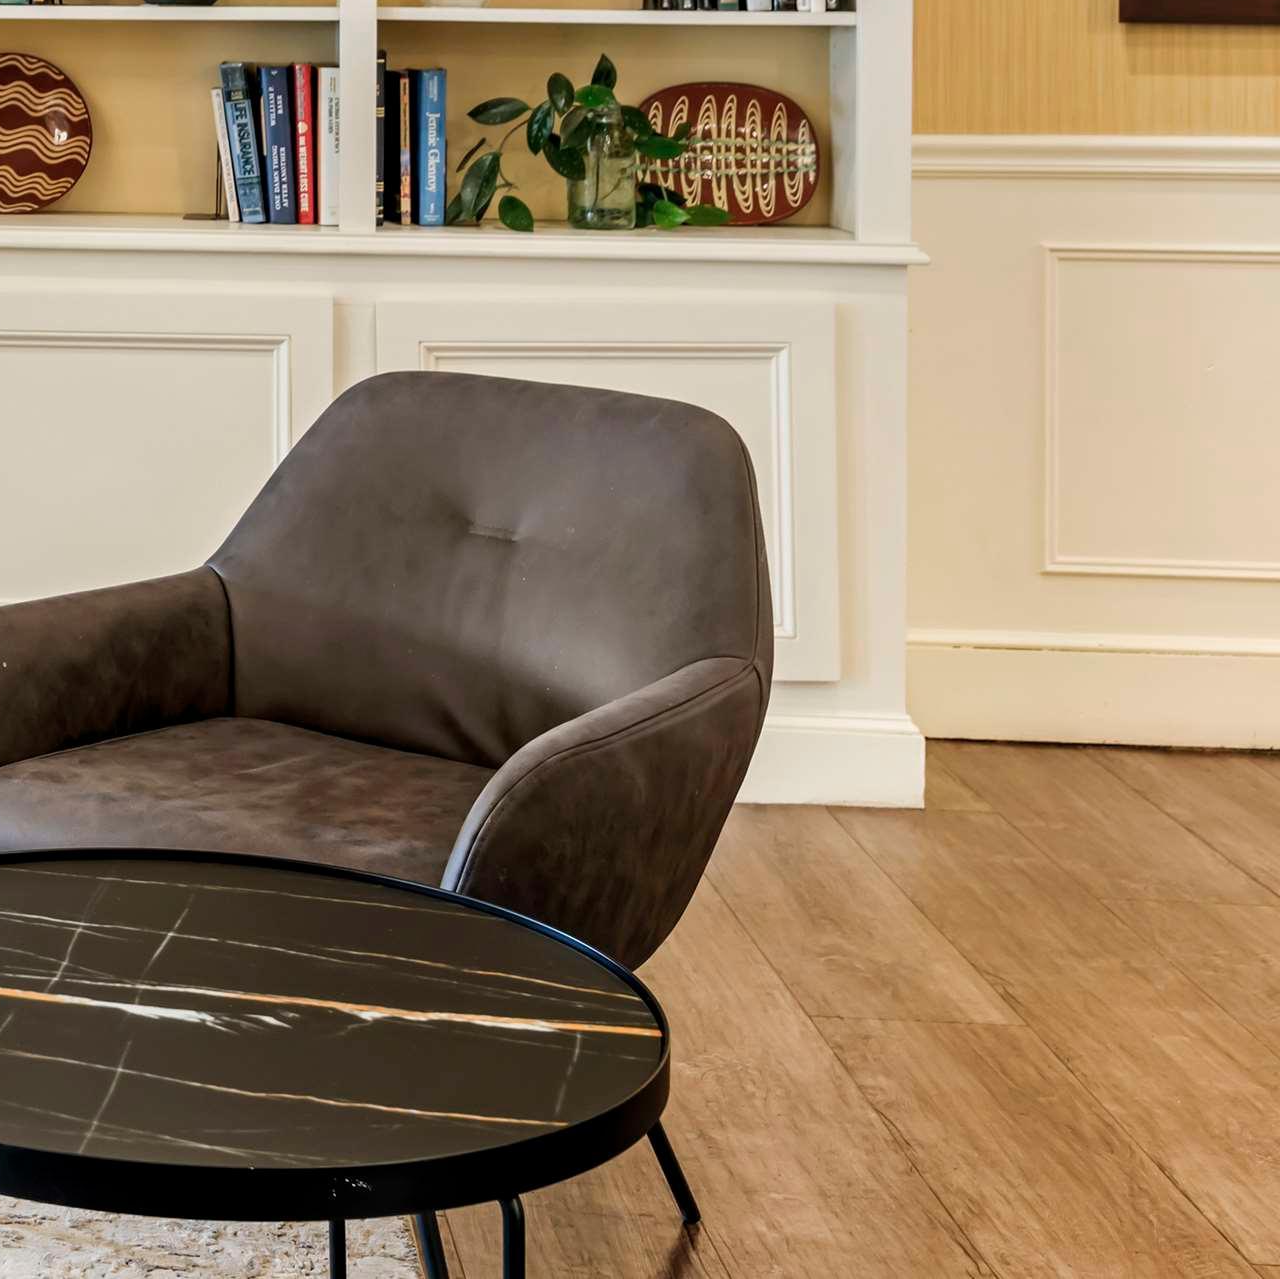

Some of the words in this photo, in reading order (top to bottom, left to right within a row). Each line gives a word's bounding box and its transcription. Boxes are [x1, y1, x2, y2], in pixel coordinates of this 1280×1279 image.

[234, 102, 249, 121] LIFE
[268, 93, 277, 127] WILLIAM
[425, 111, 441, 147] Jennie
[236, 123, 256, 177] INSURANCE
[270, 145, 279, 169] THING
[298, 147, 308, 173] WEIGHT
[278, 147, 288, 182] ANOTHER
[425, 149, 441, 193] Glenroy
[272, 170, 281, 193] DAMN
[299, 174, 308, 192] LOSS
[273, 194, 282, 210] ONE
[280, 183, 290, 208] AFTER
[299, 193, 310, 213] CURE
